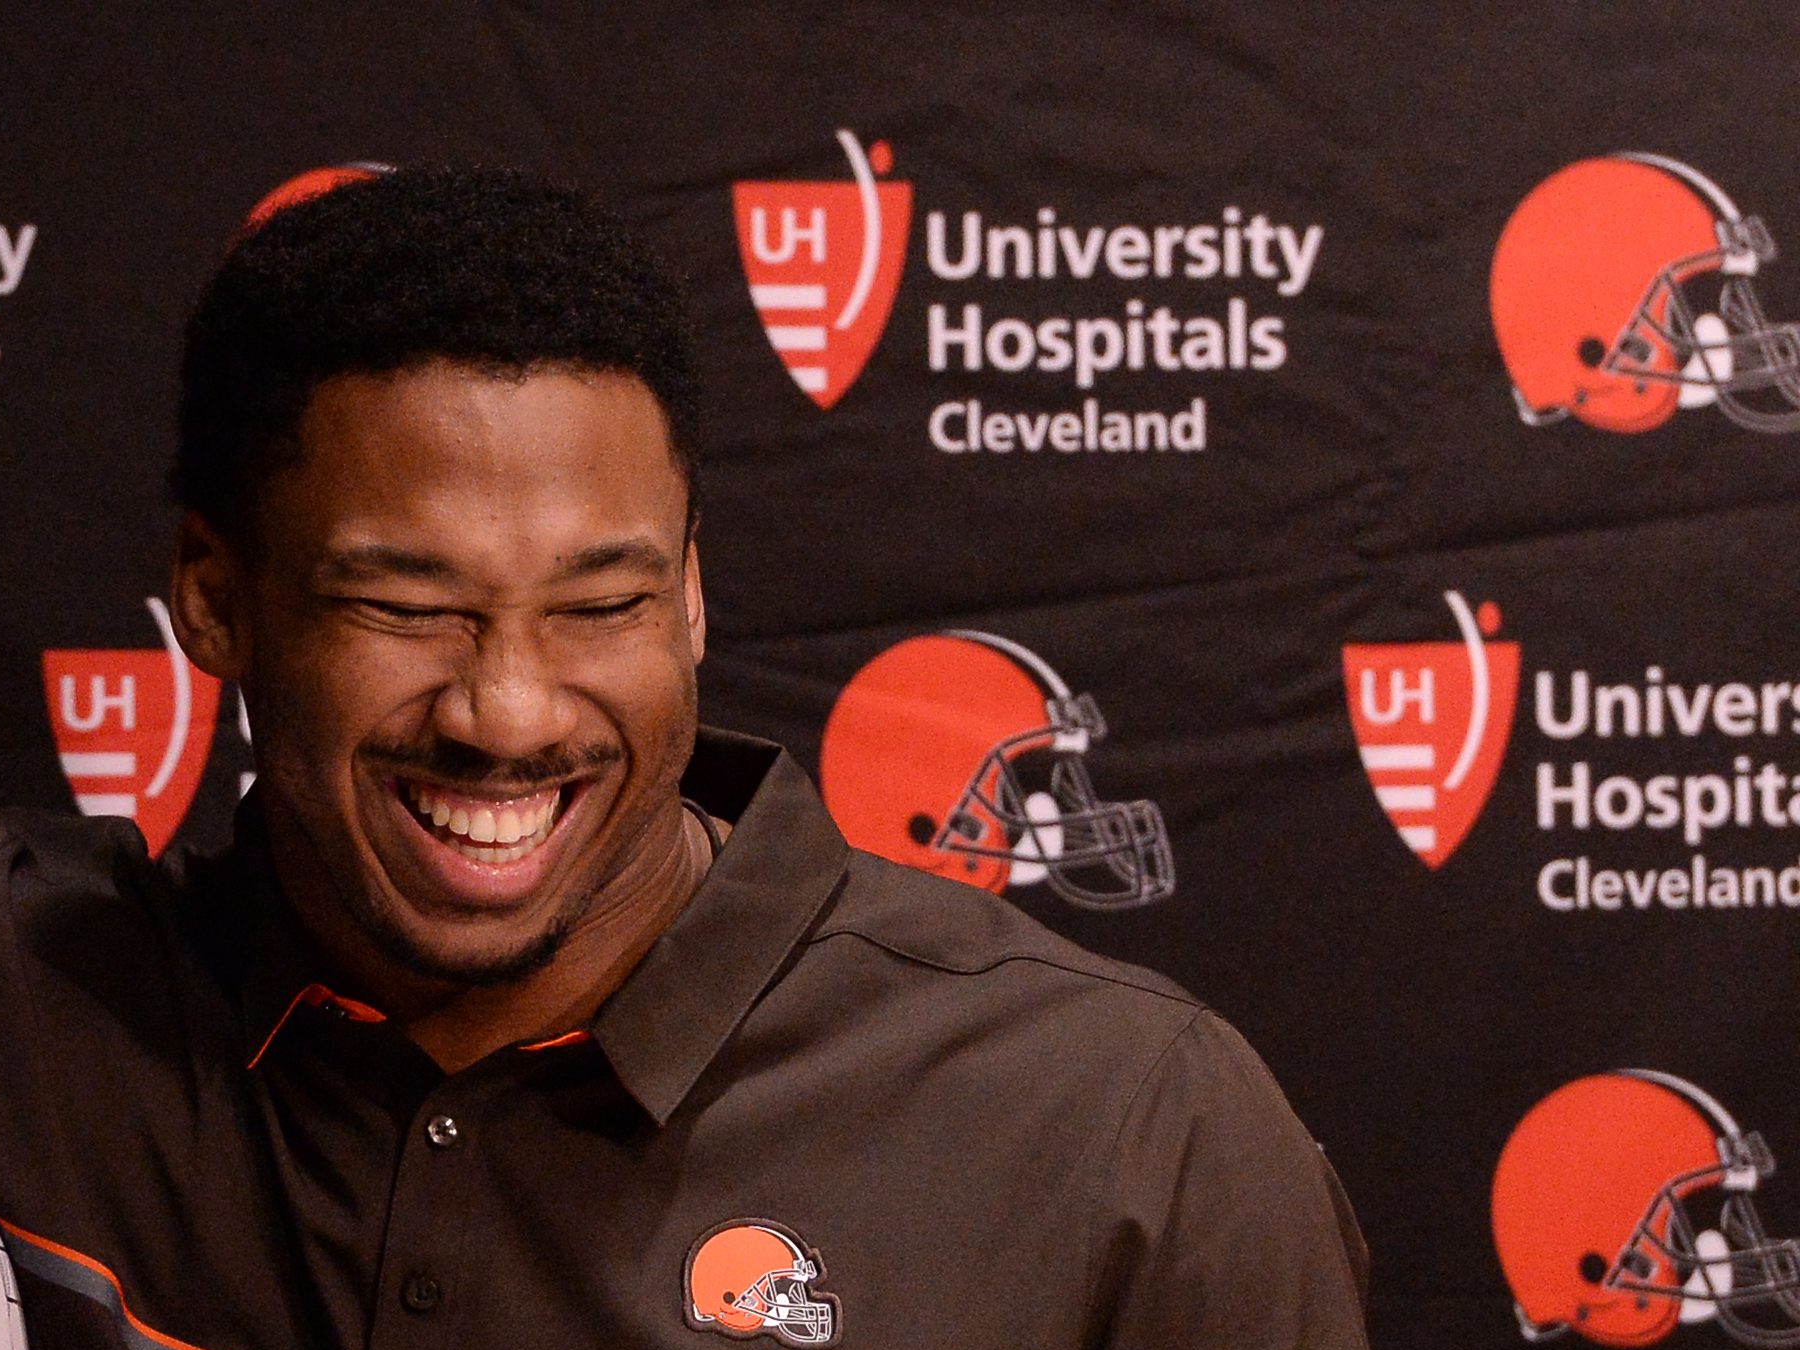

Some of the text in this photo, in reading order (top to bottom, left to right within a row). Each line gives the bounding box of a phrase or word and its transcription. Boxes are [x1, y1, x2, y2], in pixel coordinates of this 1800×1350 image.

[750, 207, 827, 265] UH
[927, 206, 1324, 297] University
[928, 297, 1287, 389] Hospitals
[928, 397, 1206, 453] Cleveland
[60, 675, 136, 732] UH
[1360, 667, 1435, 726] UH
